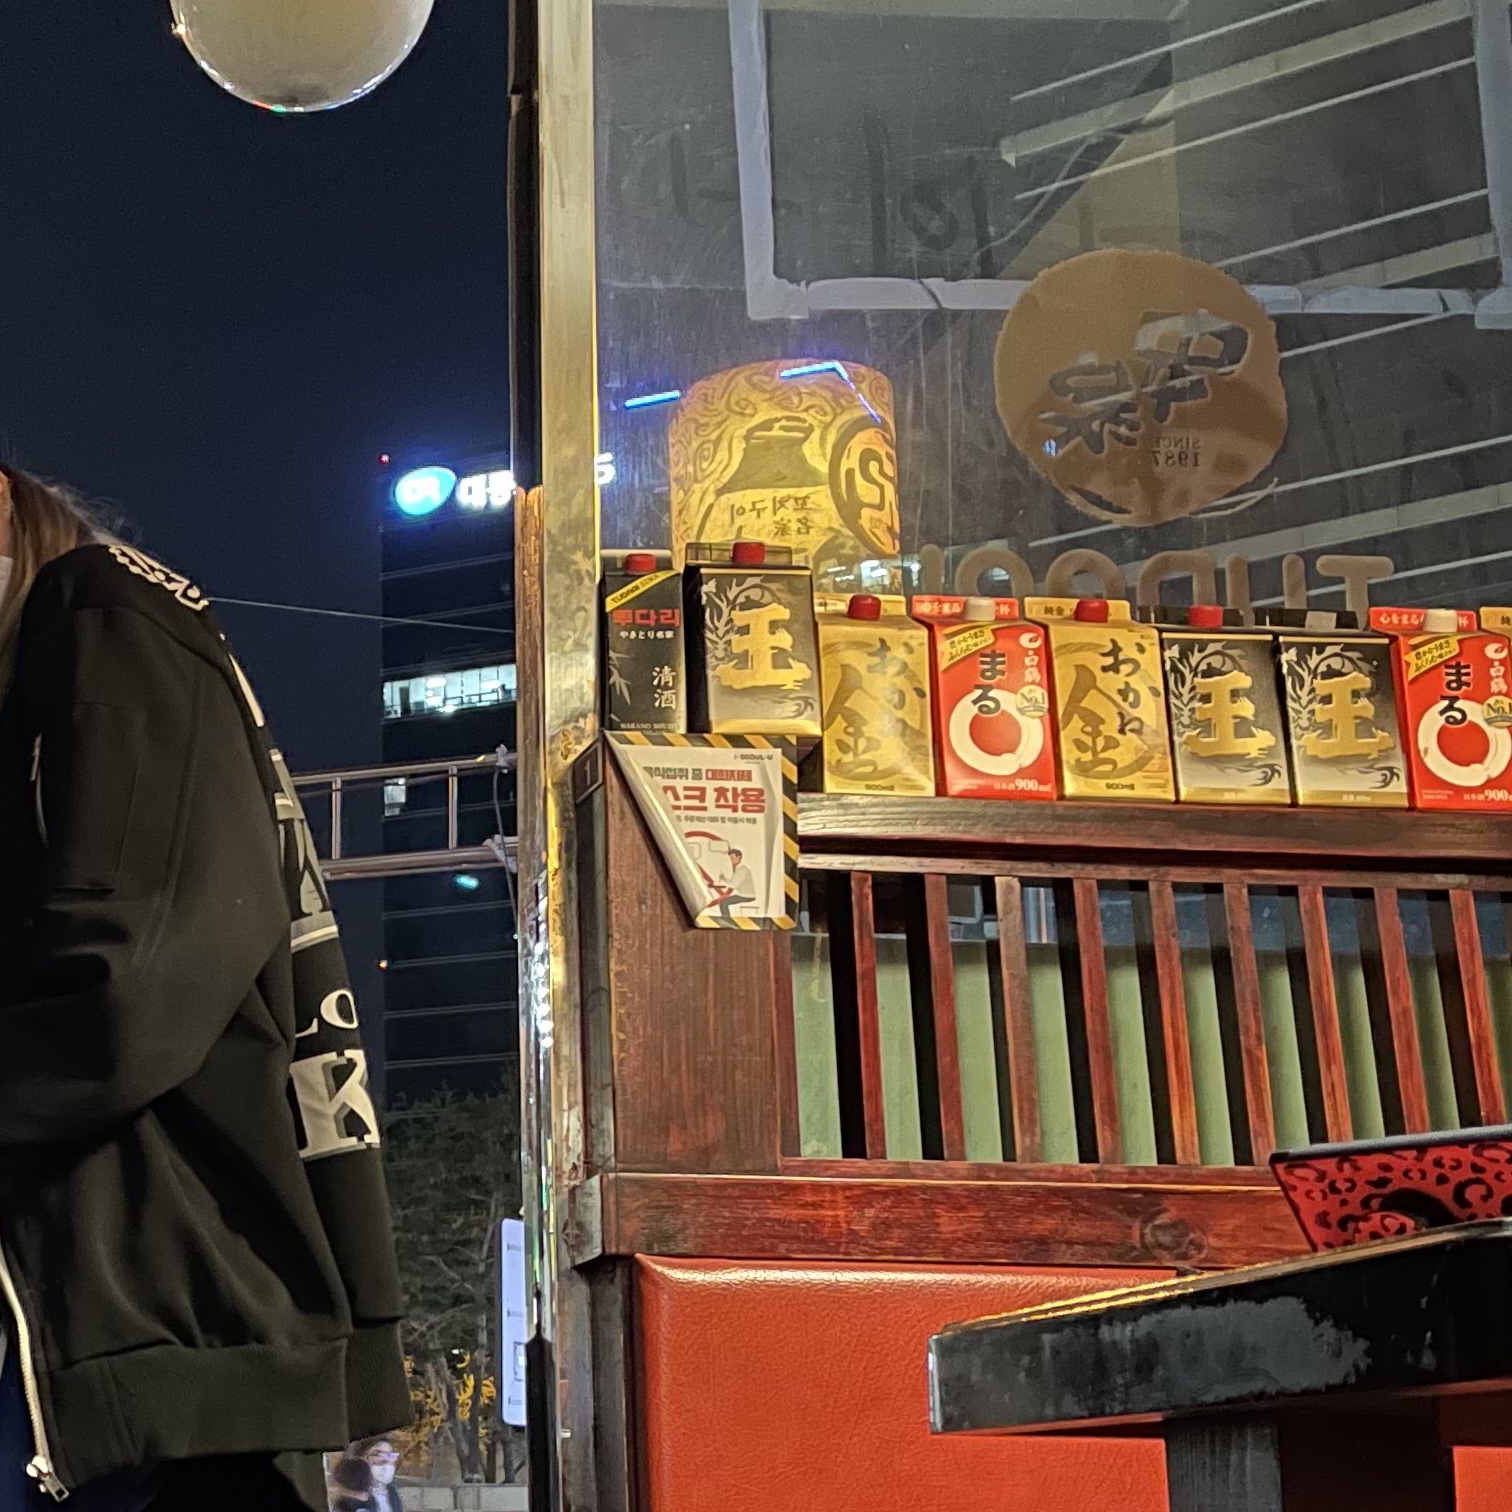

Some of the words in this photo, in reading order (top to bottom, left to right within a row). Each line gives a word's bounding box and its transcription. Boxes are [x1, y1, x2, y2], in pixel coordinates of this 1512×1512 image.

[613, 609, 680, 627] 투다리
[715, 603, 812, 689] 王
[652, 665, 677, 709] 清酒
[971, 651, 1006, 716] まる
[1183, 670, 1276, 757] 王
[1302, 672, 1394, 759] 王
[1438, 661, 1472, 726] まる
[713, 786, 766, 814] 착용
